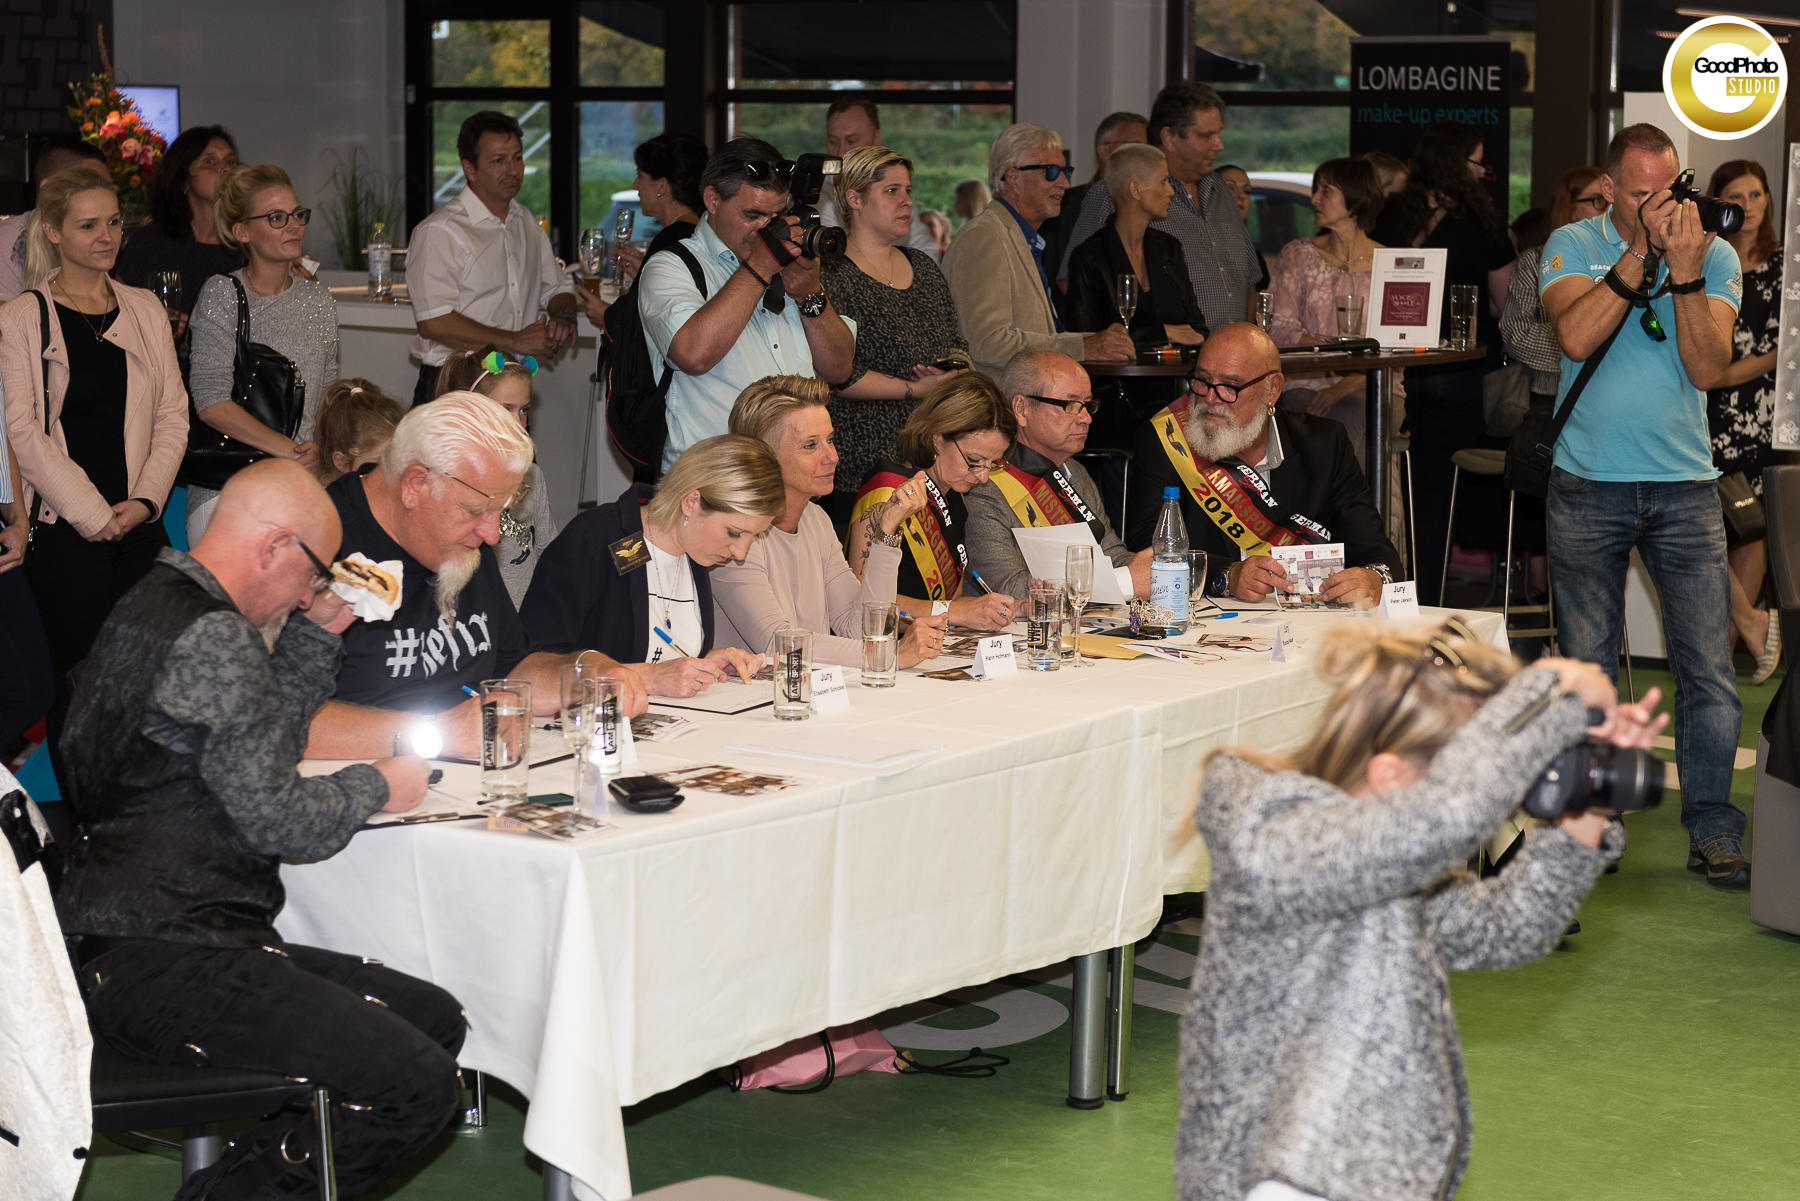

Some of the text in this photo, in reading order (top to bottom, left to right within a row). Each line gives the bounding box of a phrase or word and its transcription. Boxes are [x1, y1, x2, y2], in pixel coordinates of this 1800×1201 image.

[1358, 66, 1501, 91] LOMBAGINE
[1357, 101, 1432, 129] make-up
[1052, 470, 1096, 522] GERMAN
[1236, 464, 1279, 508] GERMAN
[1034, 484, 1073, 526] MISTE
[1192, 483, 1246, 540] 2018
[918, 507, 955, 600] SS-GERMAN
[926, 569, 943, 601] 20
[1393, 585, 1406, 594] Jury
[990, 640, 1002, 648] Jury
[791, 656, 800, 678] SPORT
[821, 672, 832, 682] Jury
